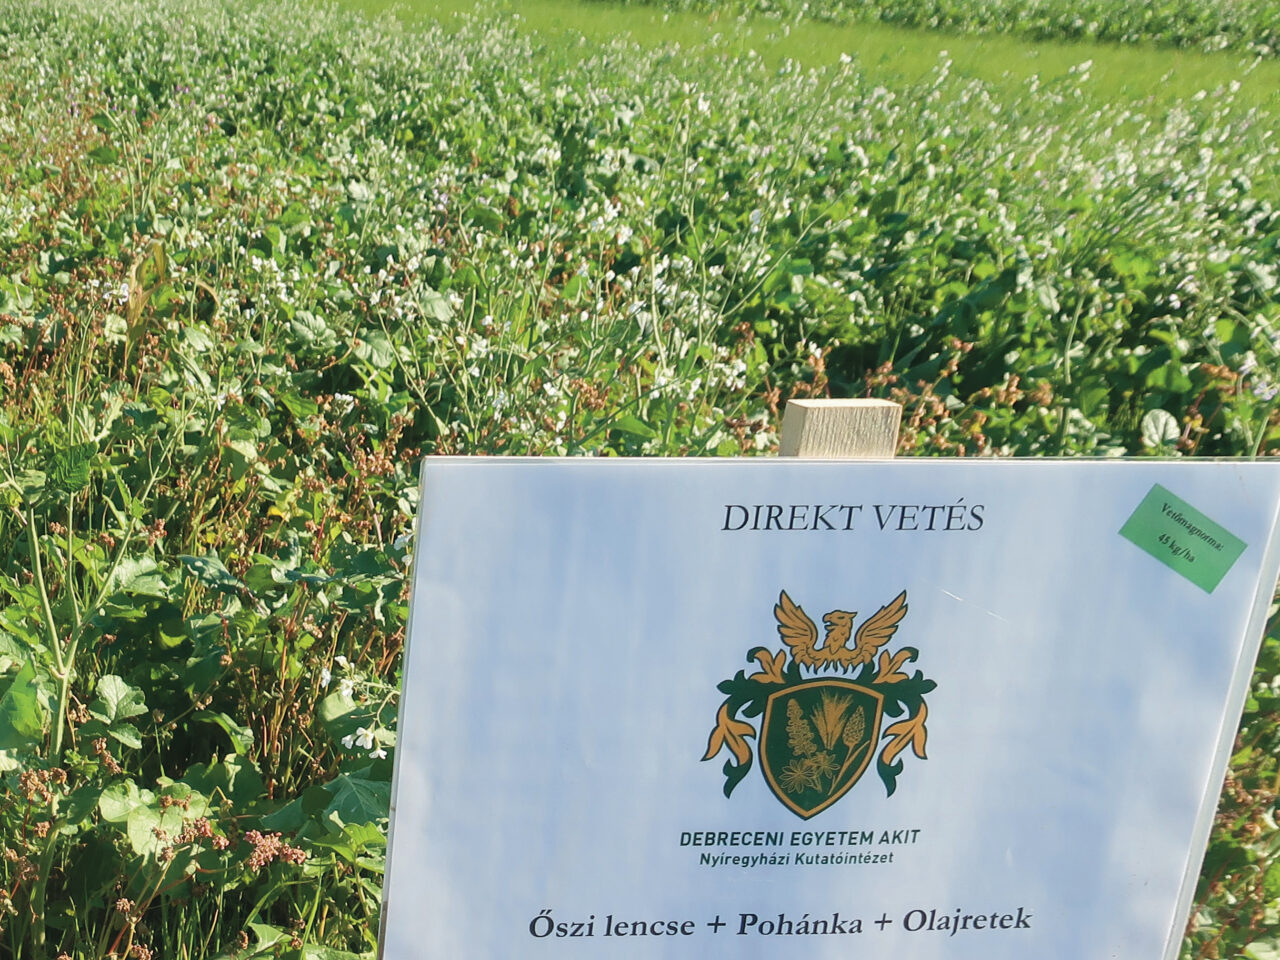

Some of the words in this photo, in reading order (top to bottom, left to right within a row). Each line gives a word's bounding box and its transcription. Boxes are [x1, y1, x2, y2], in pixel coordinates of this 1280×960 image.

[721, 504, 863, 531] DIREKT
[872, 497, 985, 531] VETÉS
[1158, 533, 1171, 545] 45
[1168, 540, 1195, 563] kg/ha
[680, 831, 784, 847] DEBRECENI
[790, 830, 874, 846] EGYETEM
[878, 829, 921, 845] AKIT
[699, 852, 790, 868] Nyíregyházi
[794, 851, 894, 865] Kutatóintézet
[529, 909, 595, 938] Őszi
[603, 915, 696, 937] lencse
[707, 915, 727, 934] +
[736, 912, 863, 936] Pohánka
[874, 913, 893, 931] +
[903, 907, 1032, 937] Olajretek
